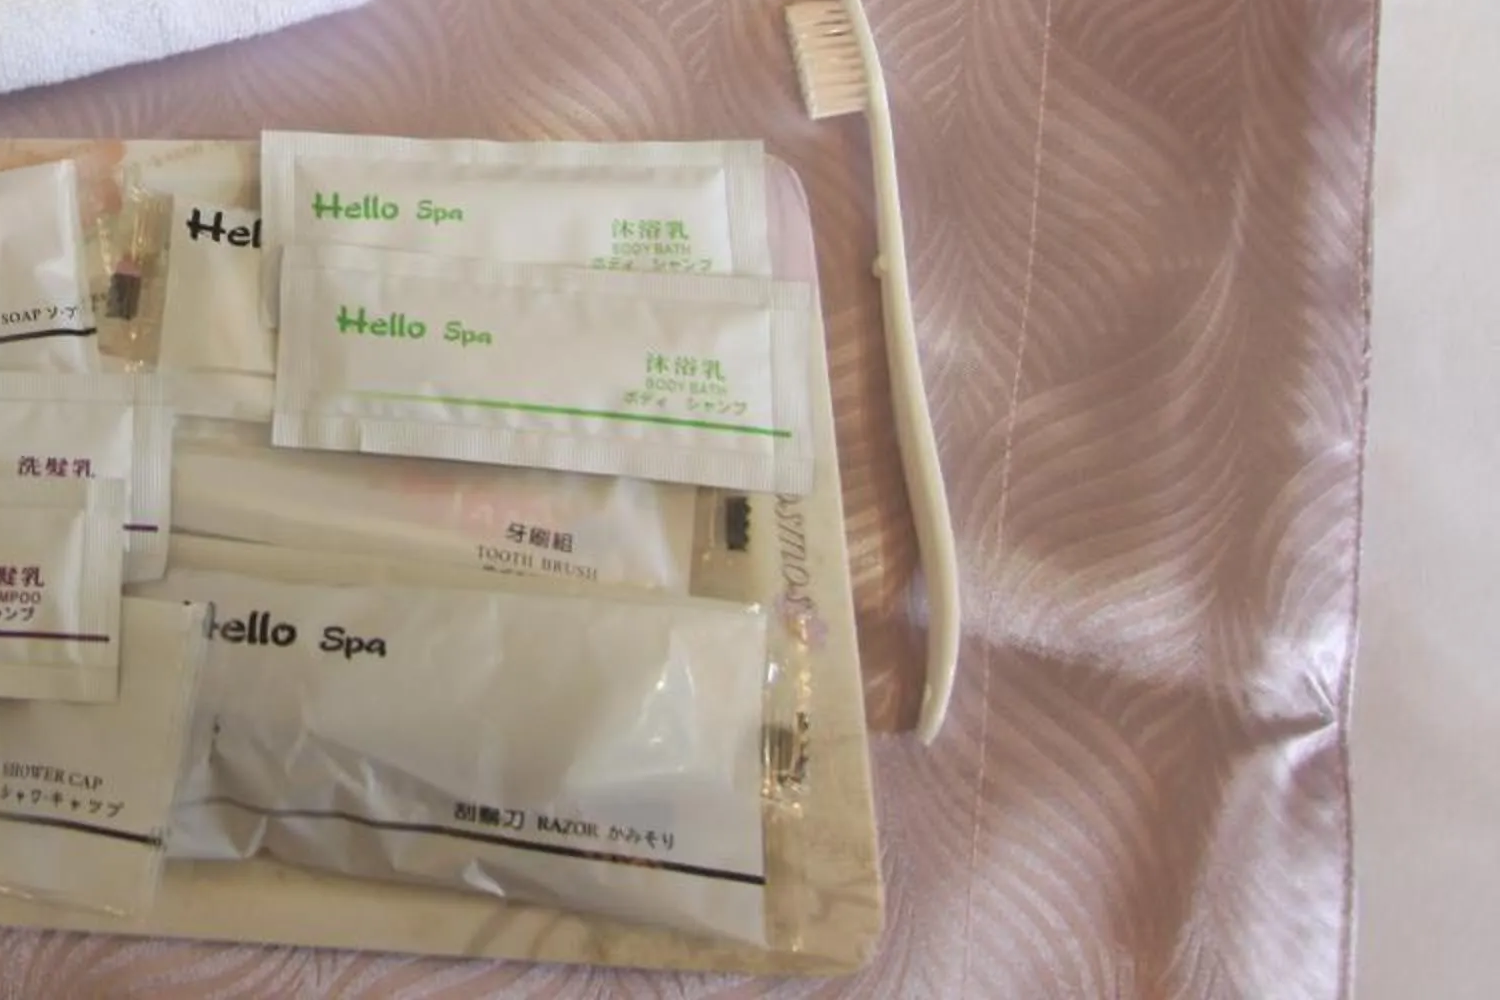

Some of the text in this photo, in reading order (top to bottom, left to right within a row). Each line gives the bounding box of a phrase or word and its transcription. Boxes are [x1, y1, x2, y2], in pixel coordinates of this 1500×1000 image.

[311, 192, 463, 224] Hello Spa
[611, 218, 689, 240] 沐浴乳
[1, 309, 42, 325] SOAP
[336, 304, 493, 347] Hello Spa
[645, 352, 727, 382] 沐浴乳
[505, 522, 574, 554] 牙刷組
[476, 543, 534, 570] TOOTH
[540, 556, 599, 582] BRUSH
[318, 625, 388, 660] Spa
[2, 761, 67, 785] SHOWER
[68, 772, 105, 791] CAP
[537, 816, 599, 839] RAZOR
